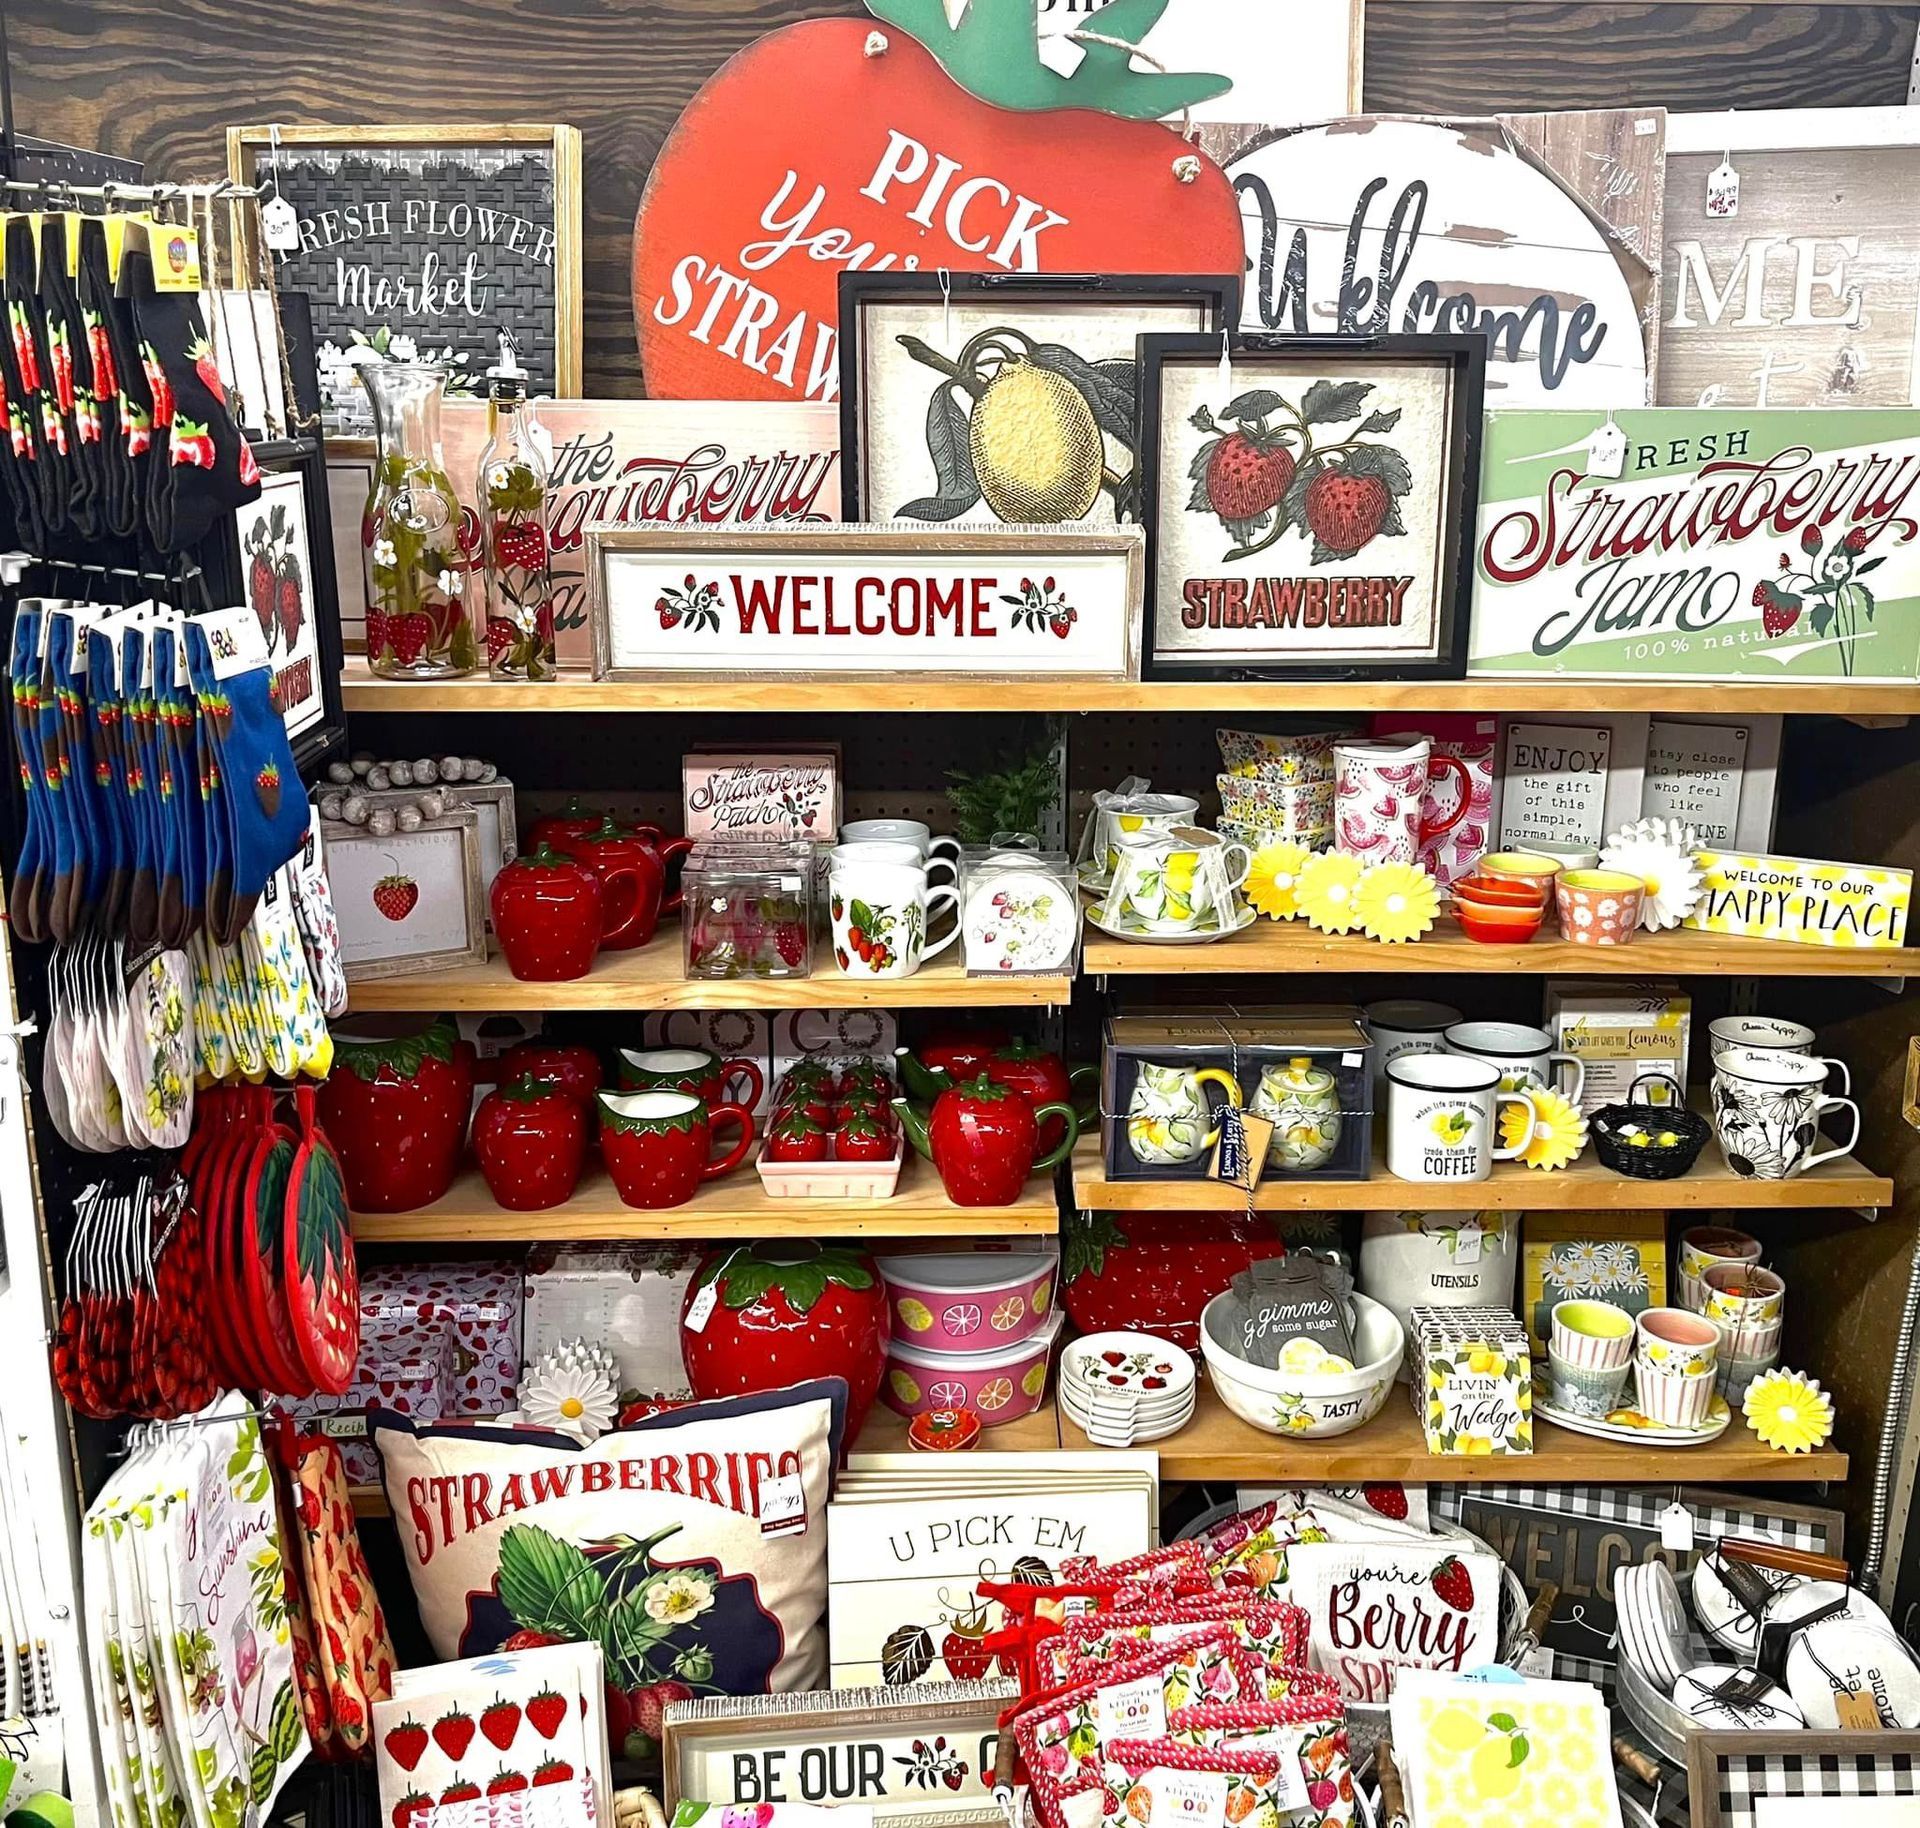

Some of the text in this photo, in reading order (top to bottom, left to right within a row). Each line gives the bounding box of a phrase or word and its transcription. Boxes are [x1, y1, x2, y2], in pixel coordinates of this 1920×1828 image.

[859, 128, 1071, 272] PICK
[403, 201, 556, 267] FLOWER
[336, 250, 488, 317] Market
[1231, 173, 1607, 390] Welcome
[548, 431, 616, 489] the
[1624, 429, 1751, 470] RESH
[1482, 446, 1920, 583] Strawberry
[729, 575, 998, 637] WELCOME
[1182, 575, 1416, 630] STRAWBERRY
[1532, 557, 1741, 658] Jam
[1624, 636, 1690, 661] 100%
[1513, 743, 1605, 775] ENJOY
[1648, 748, 1737, 766] stay close
[689, 763, 830, 813] Strawberry
[1523, 777, 1592, 795] the gift
[1653, 765, 1730, 783] to people
[1653, 781, 1723, 798] who feel
[711, 798, 780, 831] Patch
[1525, 795, 1585, 810] of this
[1669, 799, 1704, 812] like
[1523, 811, 1583, 829] simple,
[1504, 827, 1598, 846] normal day.
[1723, 869, 1874, 896] WELCOME TO OUR
[1802, 895, 1903, 942] PLACE
[1401, 1040, 1414, 1050] life
[1626, 1029, 1678, 1050] Lemons
[1415, 1105, 1432, 1121] when
[1433, 1100, 1447, 1111] life
[1449, 1100, 1466, 1109] gives
[1424, 1146, 1444, 1156] trade
[1446, 1146, 1466, 1156] them
[1424, 1155, 1478, 1177] COFFEE
[1431, 1273, 1480, 1289] UTENSILS
[1258, 1298, 1334, 1338] gimme
[1271, 1319, 1302, 1333] some
[1306, 1318, 1339, 1335] sugar
[1448, 1379, 1502, 1391] LIVIN'
[1478, 1391, 1496, 1400] the
[1322, 1397, 1364, 1419] TASTY
[1449, 1398, 1520, 1439] Wedge
[888, 1515, 1088, 1562] U PICK 'EM
[199, 1509, 270, 1626] Sunshine
[1349, 1562, 1430, 1603] you're
[1328, 1581, 1477, 1672] Berry
[733, 1744, 888, 1804] BE OUR
